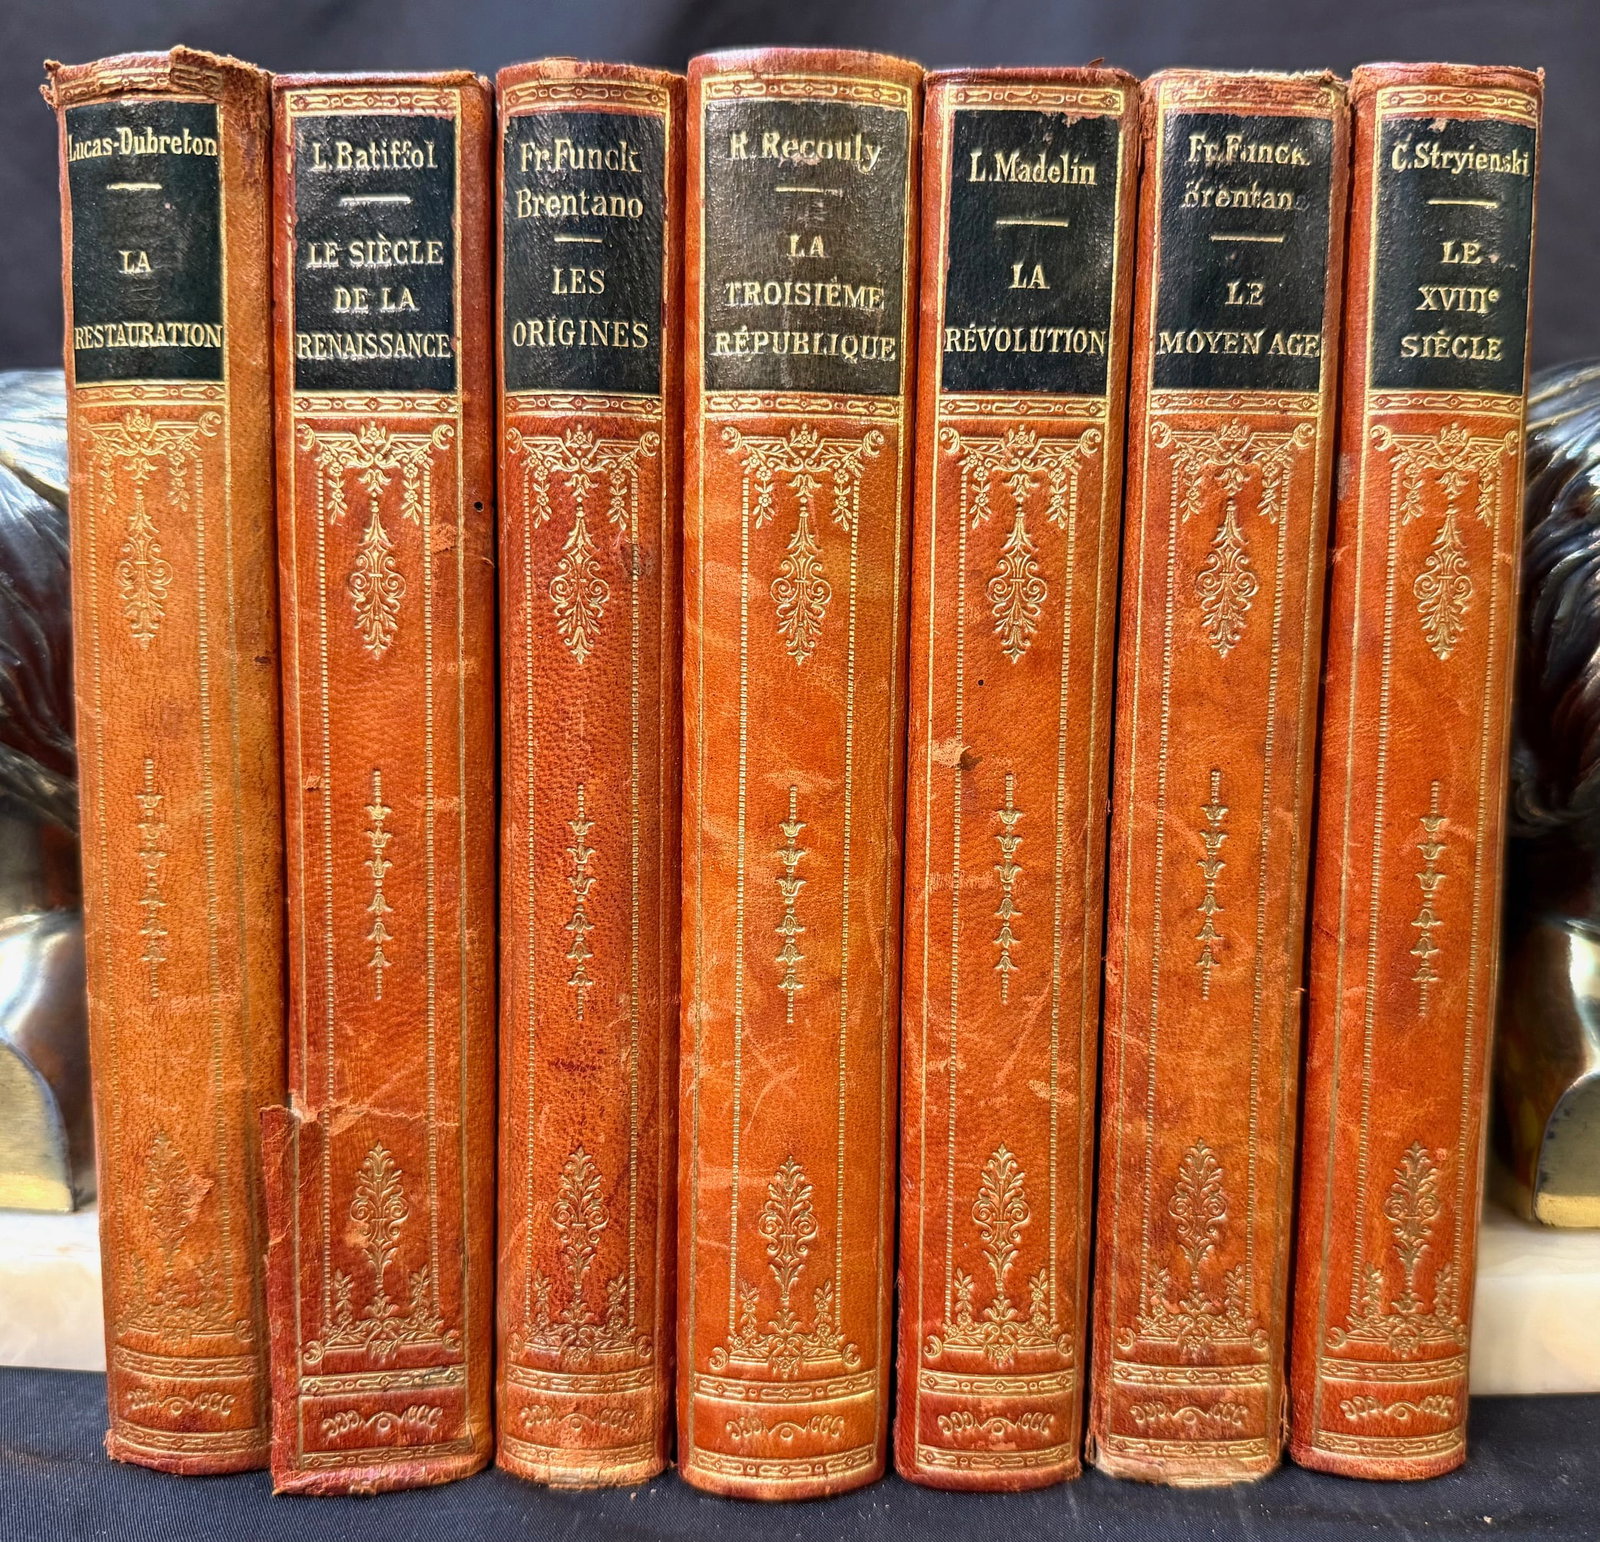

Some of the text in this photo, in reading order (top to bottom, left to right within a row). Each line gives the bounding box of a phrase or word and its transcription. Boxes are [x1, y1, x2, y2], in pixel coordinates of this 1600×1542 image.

[68, 126, 218, 162] Lucas-Dubreton
[761, 130, 882, 173] Recouly
[515, 188, 644, 219] Brentano
[306, 233, 444, 269] LE SIÈCLE
[785, 234, 828, 258] LA
[119, 250, 152, 274] LA
[1008, 261, 1051, 290] LA
[551, 268, 606, 295] LES
[1224, 280, 1265, 306] LE
[332, 288, 420, 313] DE LA
[74, 321, 223, 351] RESTAURATION
[296, 331, 453, 359] RENAISSANCE
[512, 316, 649, 349] ORIGINES
[709, 326, 894, 364] RÉPUBLIQUE
[944, 322, 1107, 355] RÉVOLUTION
[1156, 327, 1320, 359] MOYEN AGE
